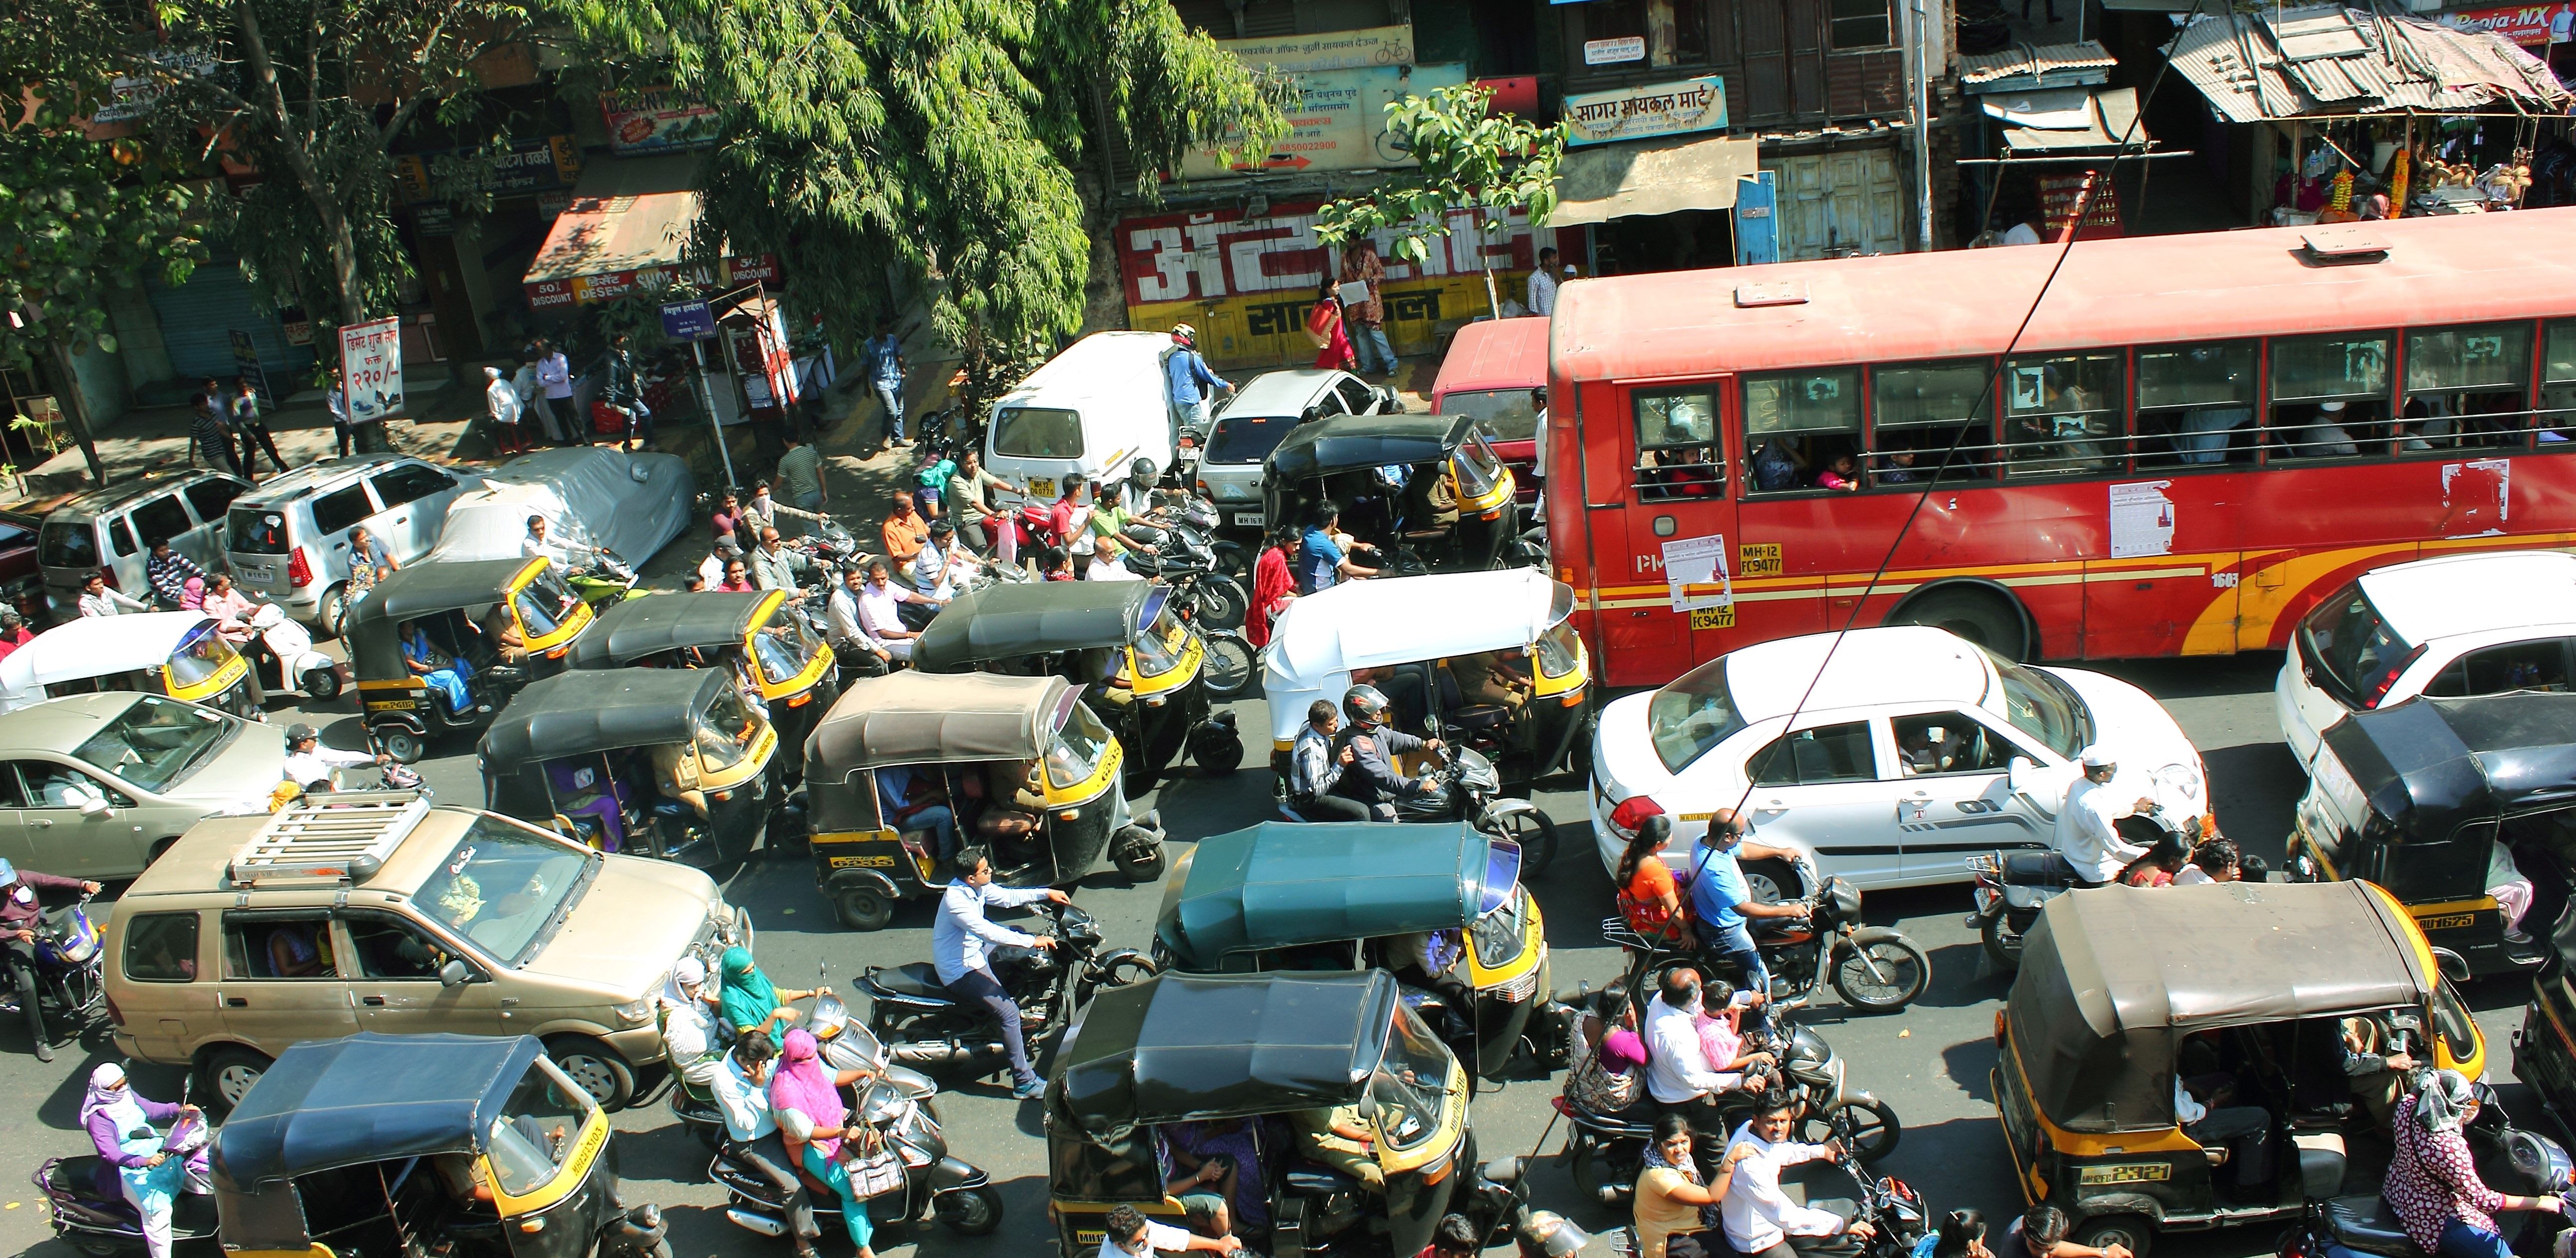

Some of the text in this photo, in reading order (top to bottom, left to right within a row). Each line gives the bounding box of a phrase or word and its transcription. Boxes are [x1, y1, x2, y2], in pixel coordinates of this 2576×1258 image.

[1322, 40, 1354, 51] सायकल
[1576, 84, 1707, 121] सागर सायकल मार्ट
[1279, 141, 1336, 153] 9850022900
[733, 267, 773, 281] DISCOUNT
[532, 292, 572, 307] DISCOUNT
[346, 325, 397, 352] डिसेंट शुज सेल
[364, 354, 382, 366] फक्त
[268, 529, 275, 544] L
[1743, 546, 1777, 557] MH-12
[2212, 573, 2239, 589] 1603
[1102, 747, 1120, 782] 6235
[832, 858, 894, 867] 6235
[732, 1172, 764, 1188] Pleasure
[2111, 1164, 2170, 1181] 2321
